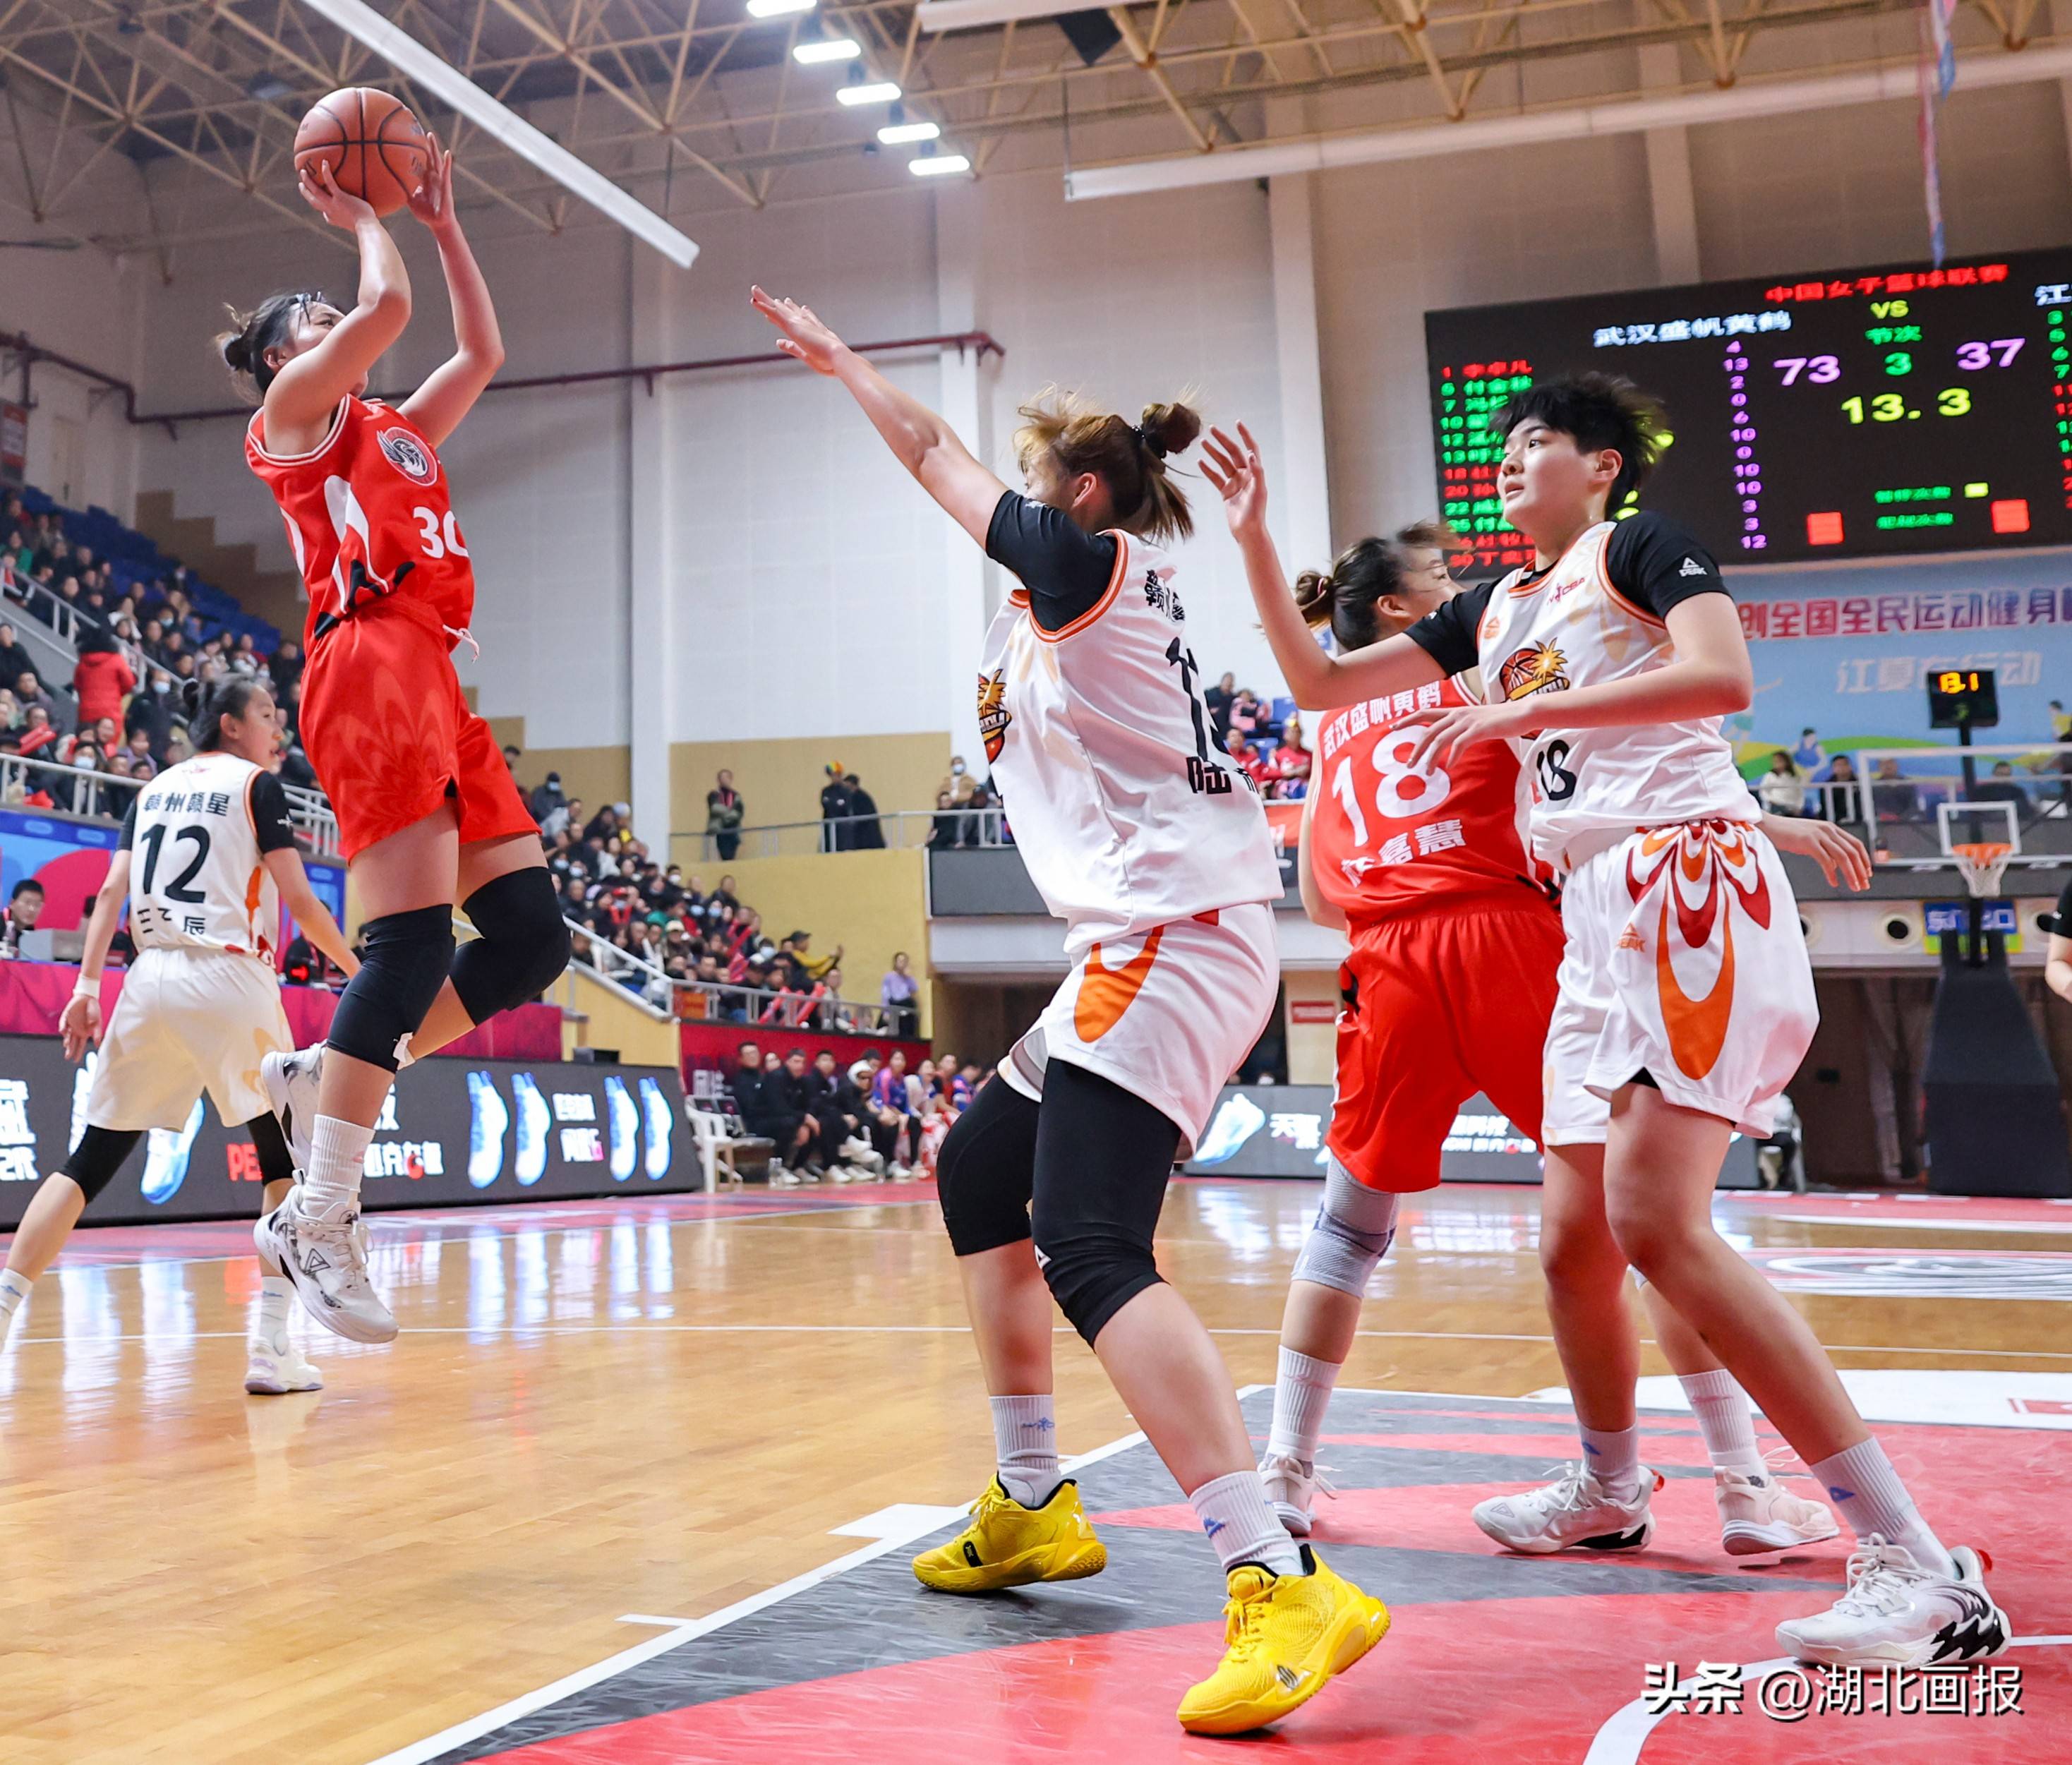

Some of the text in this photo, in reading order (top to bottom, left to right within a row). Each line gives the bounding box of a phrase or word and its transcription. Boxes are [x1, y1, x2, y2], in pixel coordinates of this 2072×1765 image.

[1871, 300, 1910, 319] VS
[1593, 309, 1792, 347] 武汉盛帆黄鹤
[1956, 338, 2026, 371] 37
[1723, 357, 1749, 372] 13
[1773, 355, 1841, 386] 73
[1884, 352, 1913, 376] 3
[1730, 375, 1745, 390] 2
[1731, 392, 1747, 406] 0
[1730, 428, 1757, 442] 10
[1736, 445, 1752, 459] 0
[1733, 463, 1760, 478] 10
[1735, 480, 1761, 495] 10
[1742, 499, 1757, 514] 3
[1741, 534, 1767, 550] 12
[1332, 725, 1451, 848] 18
[140, 823, 210, 904] 12
